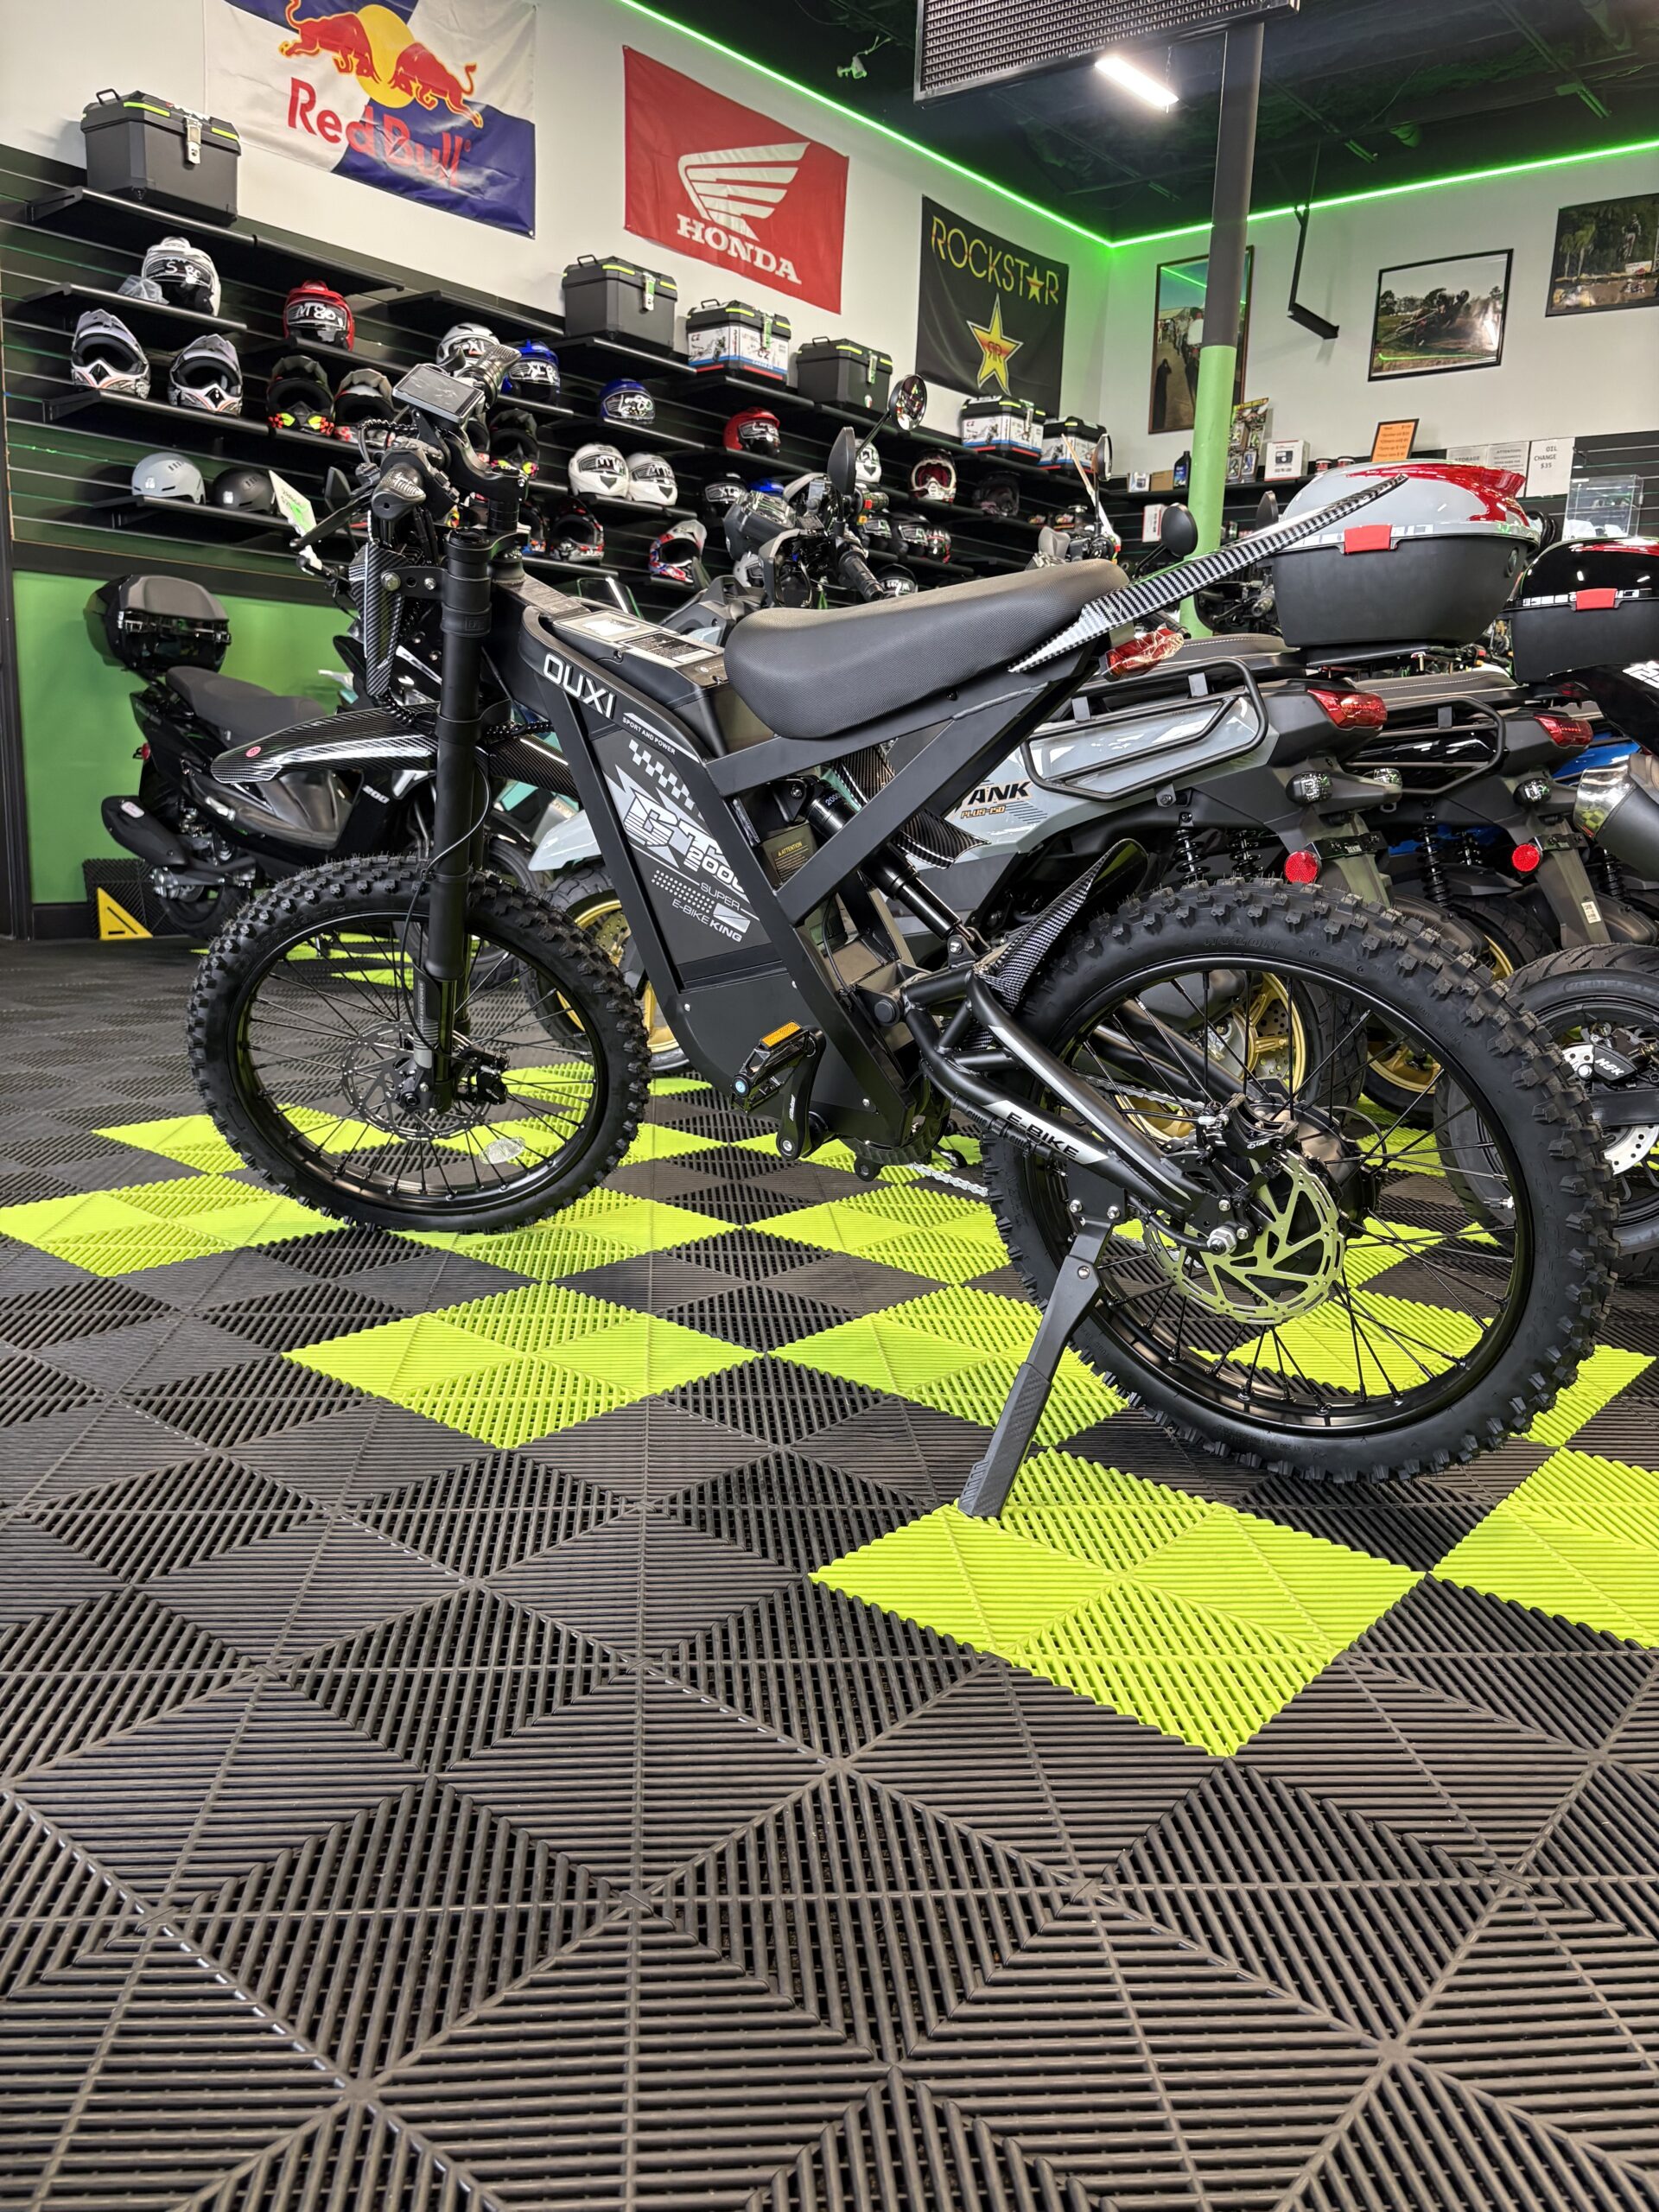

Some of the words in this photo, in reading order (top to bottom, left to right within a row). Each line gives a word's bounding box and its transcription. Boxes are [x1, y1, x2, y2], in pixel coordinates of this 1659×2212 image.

[288, 77, 375, 156] Red
[383, 113, 463, 188] Bull
[677, 213, 803, 285] HONDA
[543, 652, 616, 719] OUXI
[621, 716, 642, 733] SPORT
[641, 729, 654, 742] AND
[654, 735, 677, 755] POWER
[960, 780, 1032, 808] ANK
[960, 804, 1006, 819] PLUS-150
[624, 788, 725, 856] GT
[781, 841, 804, 855] ATTENTION
[700, 882, 741, 911] SUPER
[671, 899, 709, 925] E-BIKE
[709, 920, 743, 944] KING
[1006, 1111, 1079, 1159] E-BIKE
